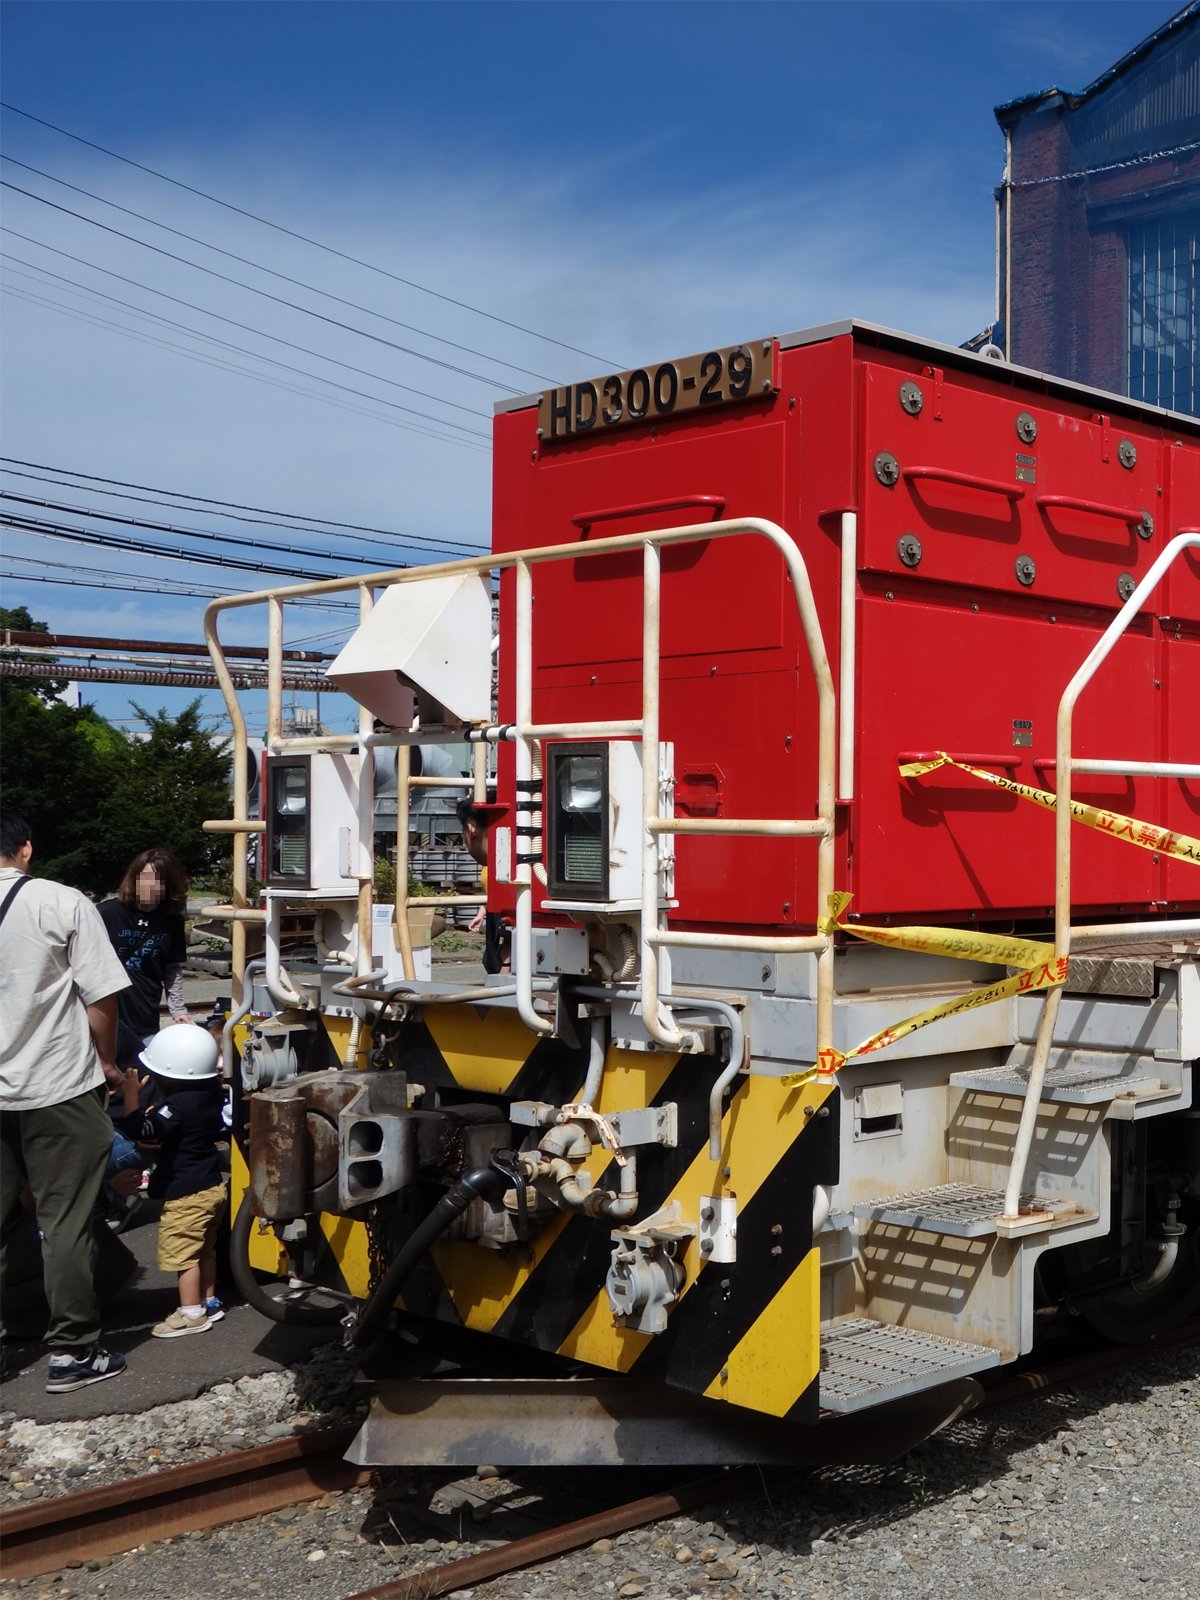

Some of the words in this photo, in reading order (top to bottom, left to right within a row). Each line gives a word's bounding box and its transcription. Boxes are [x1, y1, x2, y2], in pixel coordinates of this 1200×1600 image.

[551, 345, 753, 437] HD300-29
[1095, 812, 1178, 855] 立入禁止
